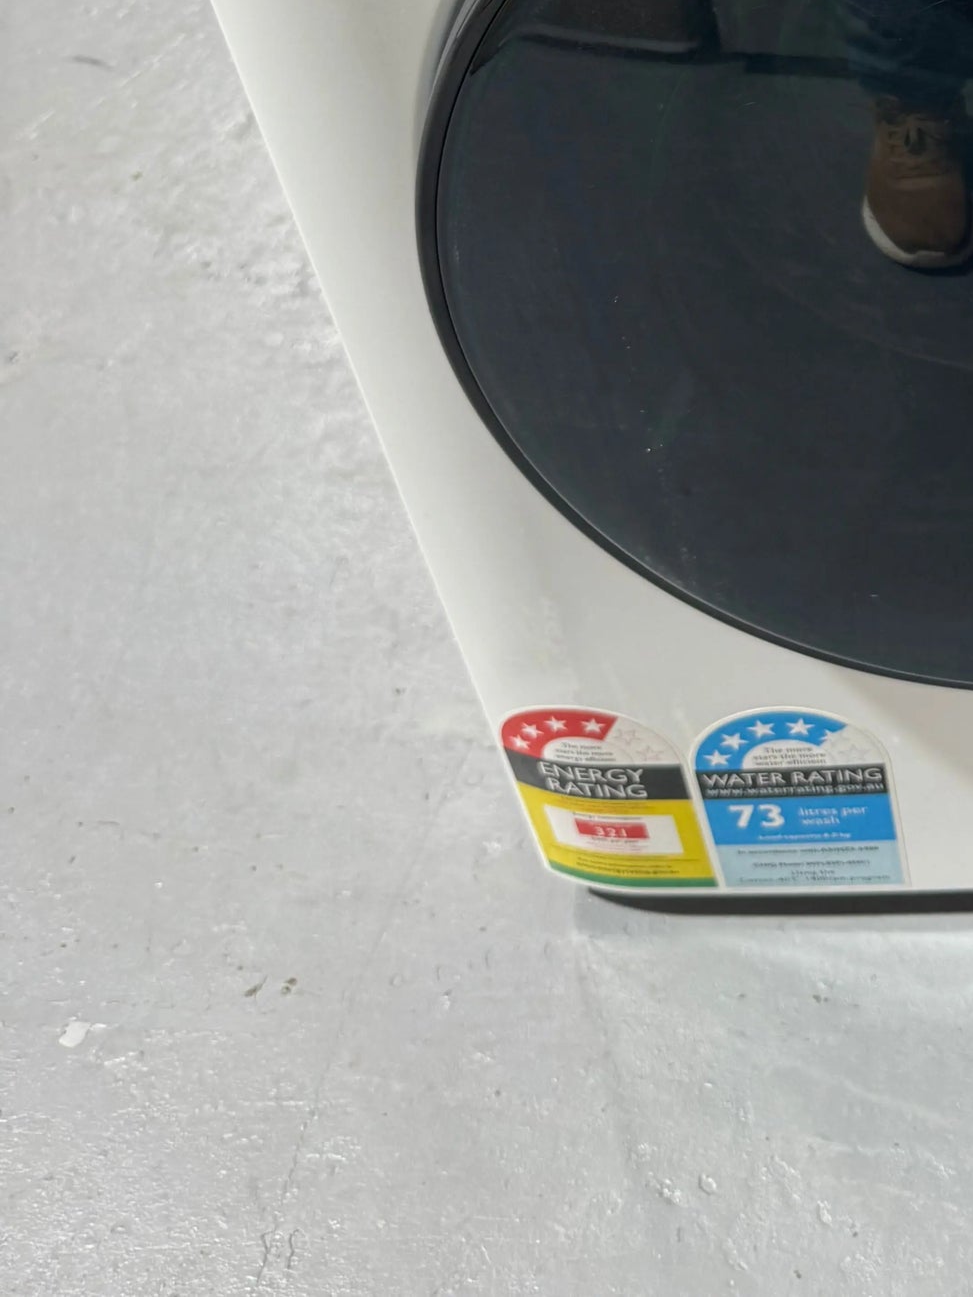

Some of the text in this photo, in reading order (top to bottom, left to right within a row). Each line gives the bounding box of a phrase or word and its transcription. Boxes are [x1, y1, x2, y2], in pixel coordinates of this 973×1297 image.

[537, 760, 644, 784] ENERGY
[703, 767, 883, 788] WATER RATING
[545, 777, 648, 799] RATING
[728, 803, 785, 829] 73
[841, 805, 869, 817] per
